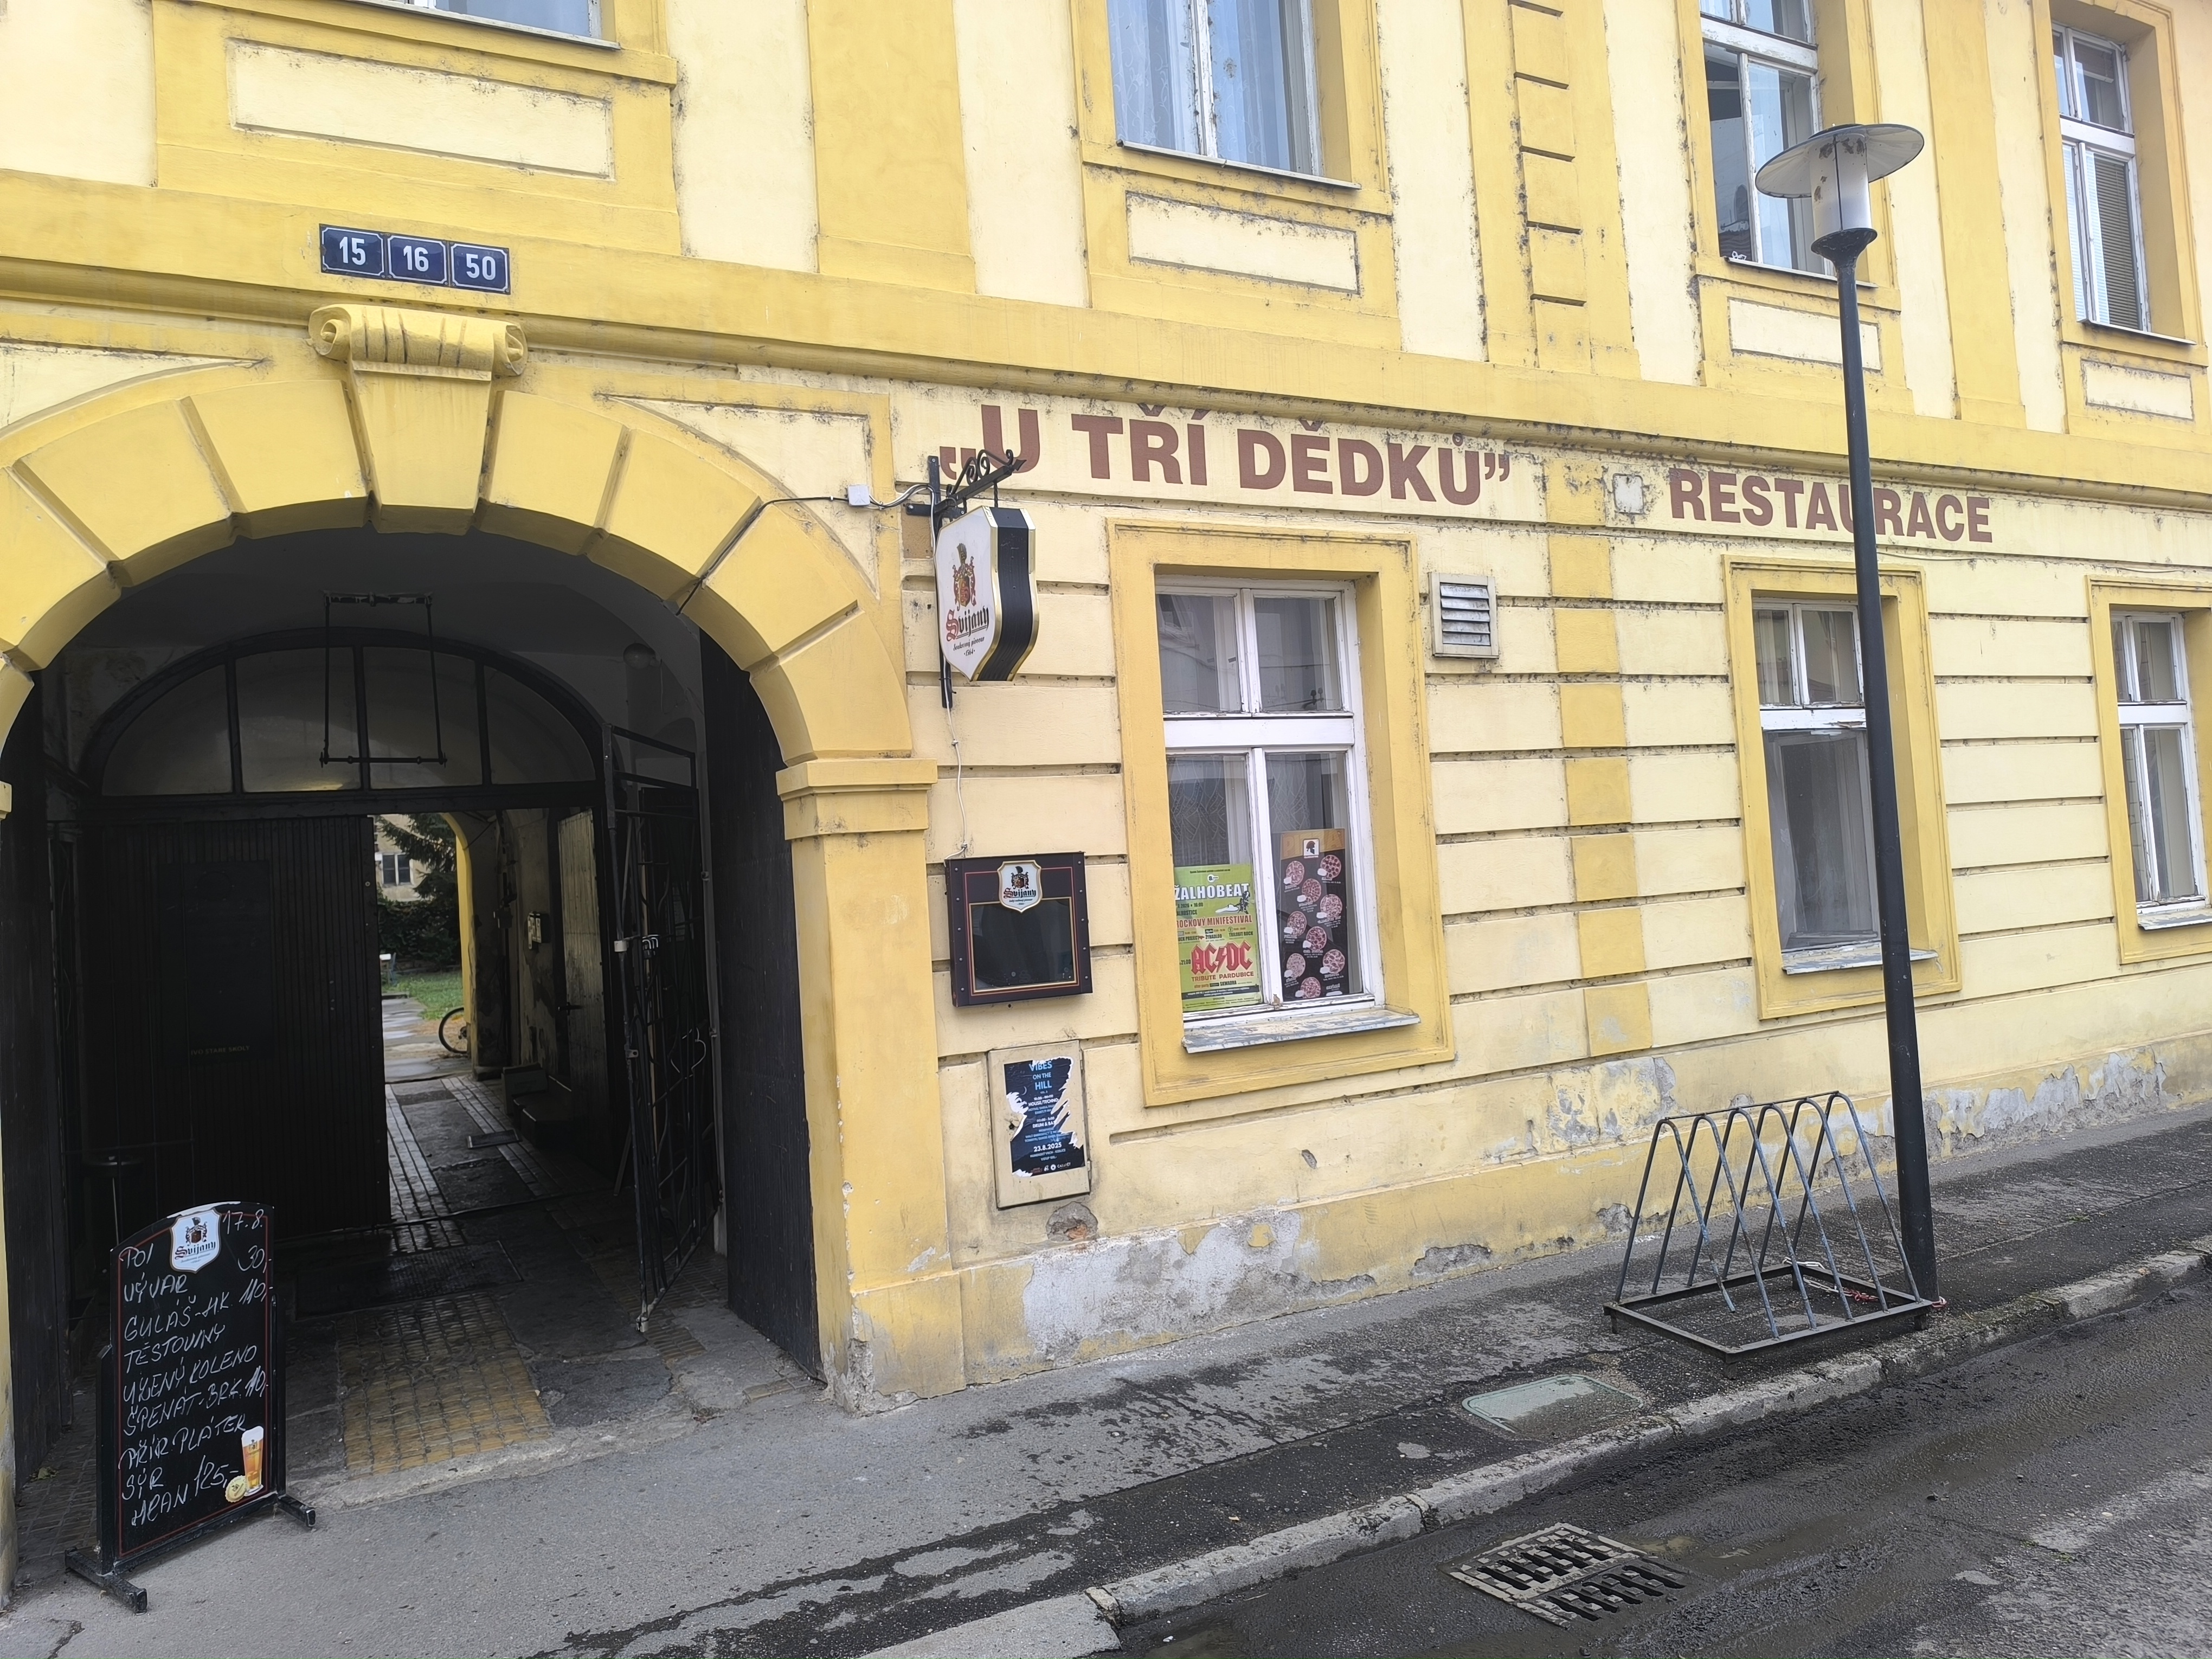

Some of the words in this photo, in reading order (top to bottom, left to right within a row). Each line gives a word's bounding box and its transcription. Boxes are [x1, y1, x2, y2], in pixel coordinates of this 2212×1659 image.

[339, 236, 366, 266] 15
[403, 245, 429, 272] 16
[466, 253, 496, 280] 50
[1071, 402, 1212, 486] TŘÍ
[946, 606, 989, 642] Svijany
[1004, 888, 1036, 898] Svijany
[1174, 883, 1249, 901] ŽALHOBEAT
[1207, 915, 1252, 926] MINIFESTIVAL
[1219, 971, 1254, 980] PARDUBICE
[1028, 1060, 1053, 1072] VIBES
[1034, 1080, 1052, 1090] HILL
[1033, 1142, 1062, 1152] 23.8.2025
[175, 1242, 216, 1259] Svijany
[124, 1271, 188, 1303] VÝVAR
[189, 1345, 257, 1384] KOLENO
[121, 1467, 164, 1500] SÝR
